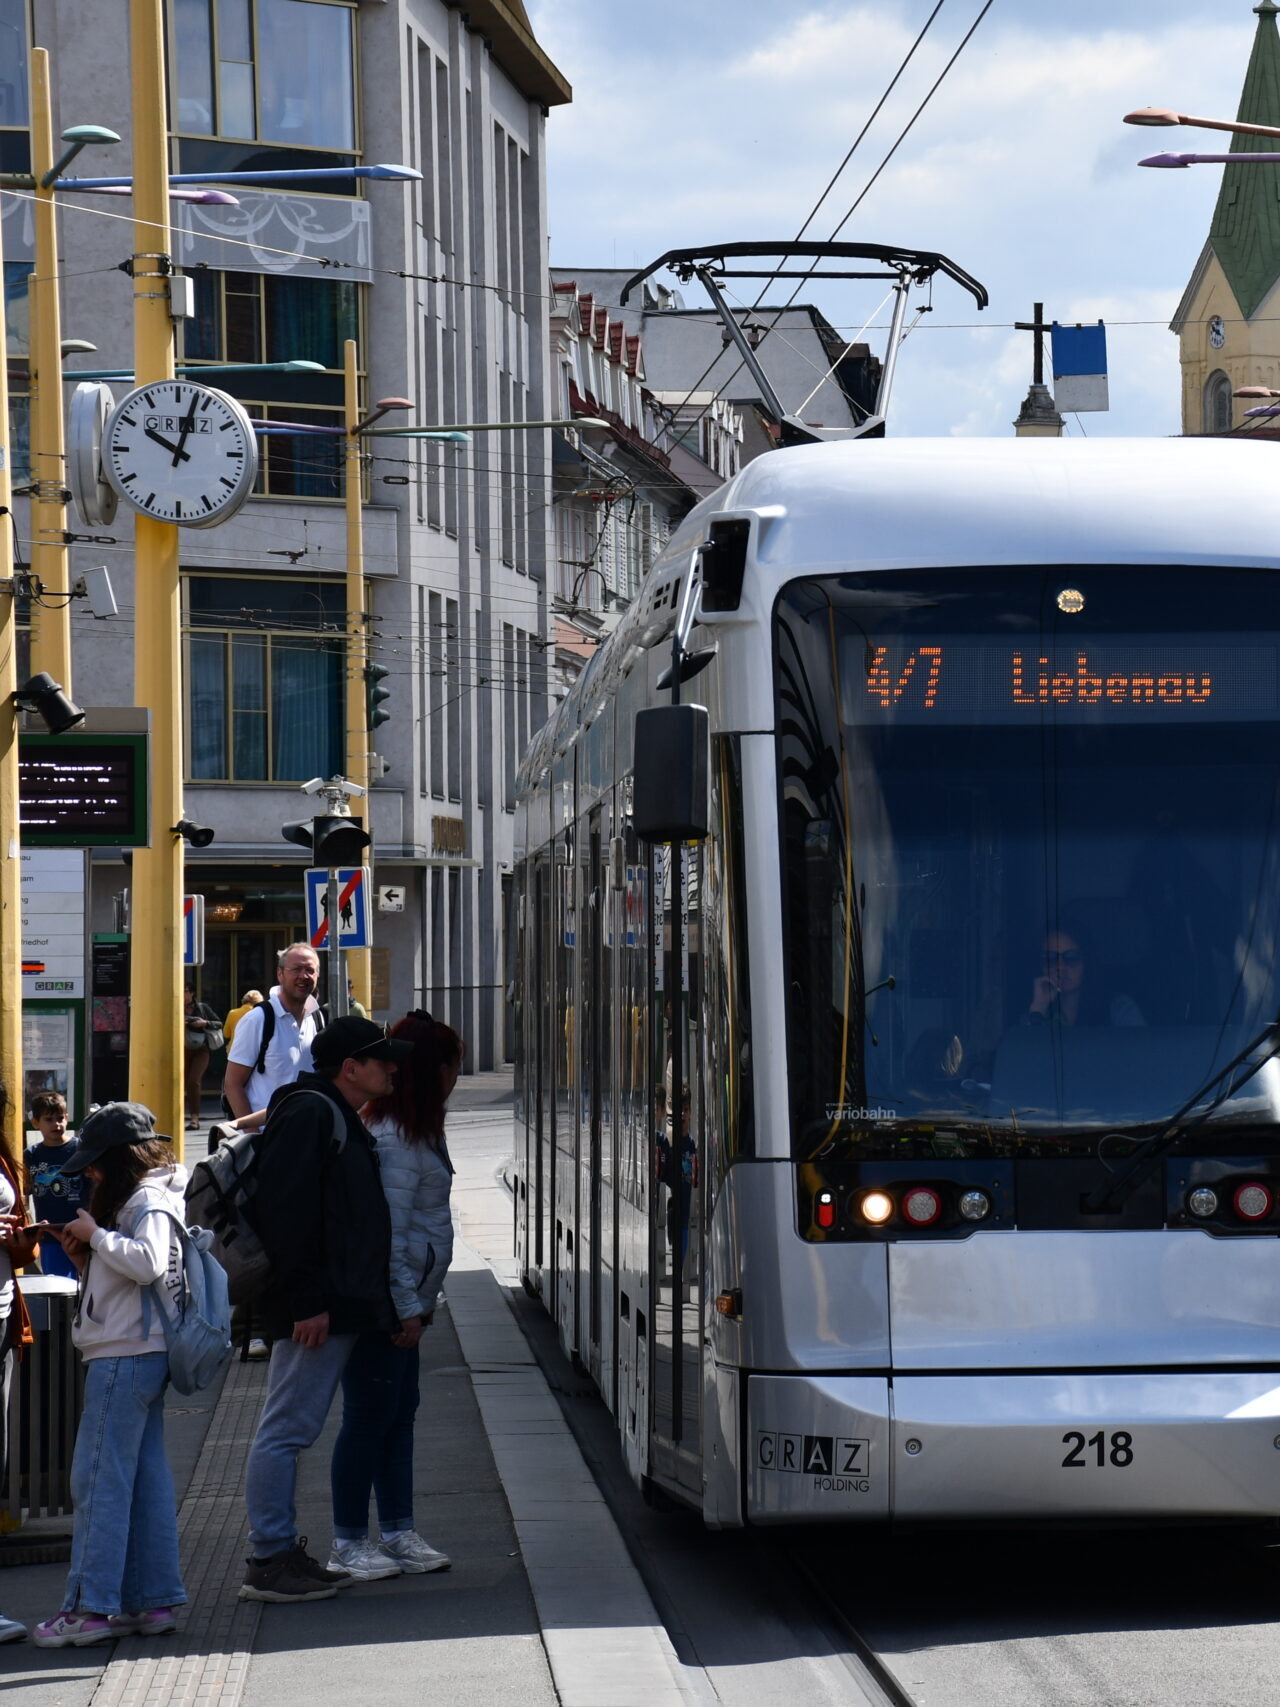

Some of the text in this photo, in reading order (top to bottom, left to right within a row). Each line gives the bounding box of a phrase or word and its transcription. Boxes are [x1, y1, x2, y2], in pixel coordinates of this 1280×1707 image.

[867, 648, 1211, 708] 4/7 Liebenau
[35, 981, 74, 991] GRAZ
[825, 1106, 897, 1121] variobahn
[757, 1432, 869, 1477] GRAZ
[1061, 1430, 1134, 1468] 218
[813, 1476, 870, 1493] HOLDING
